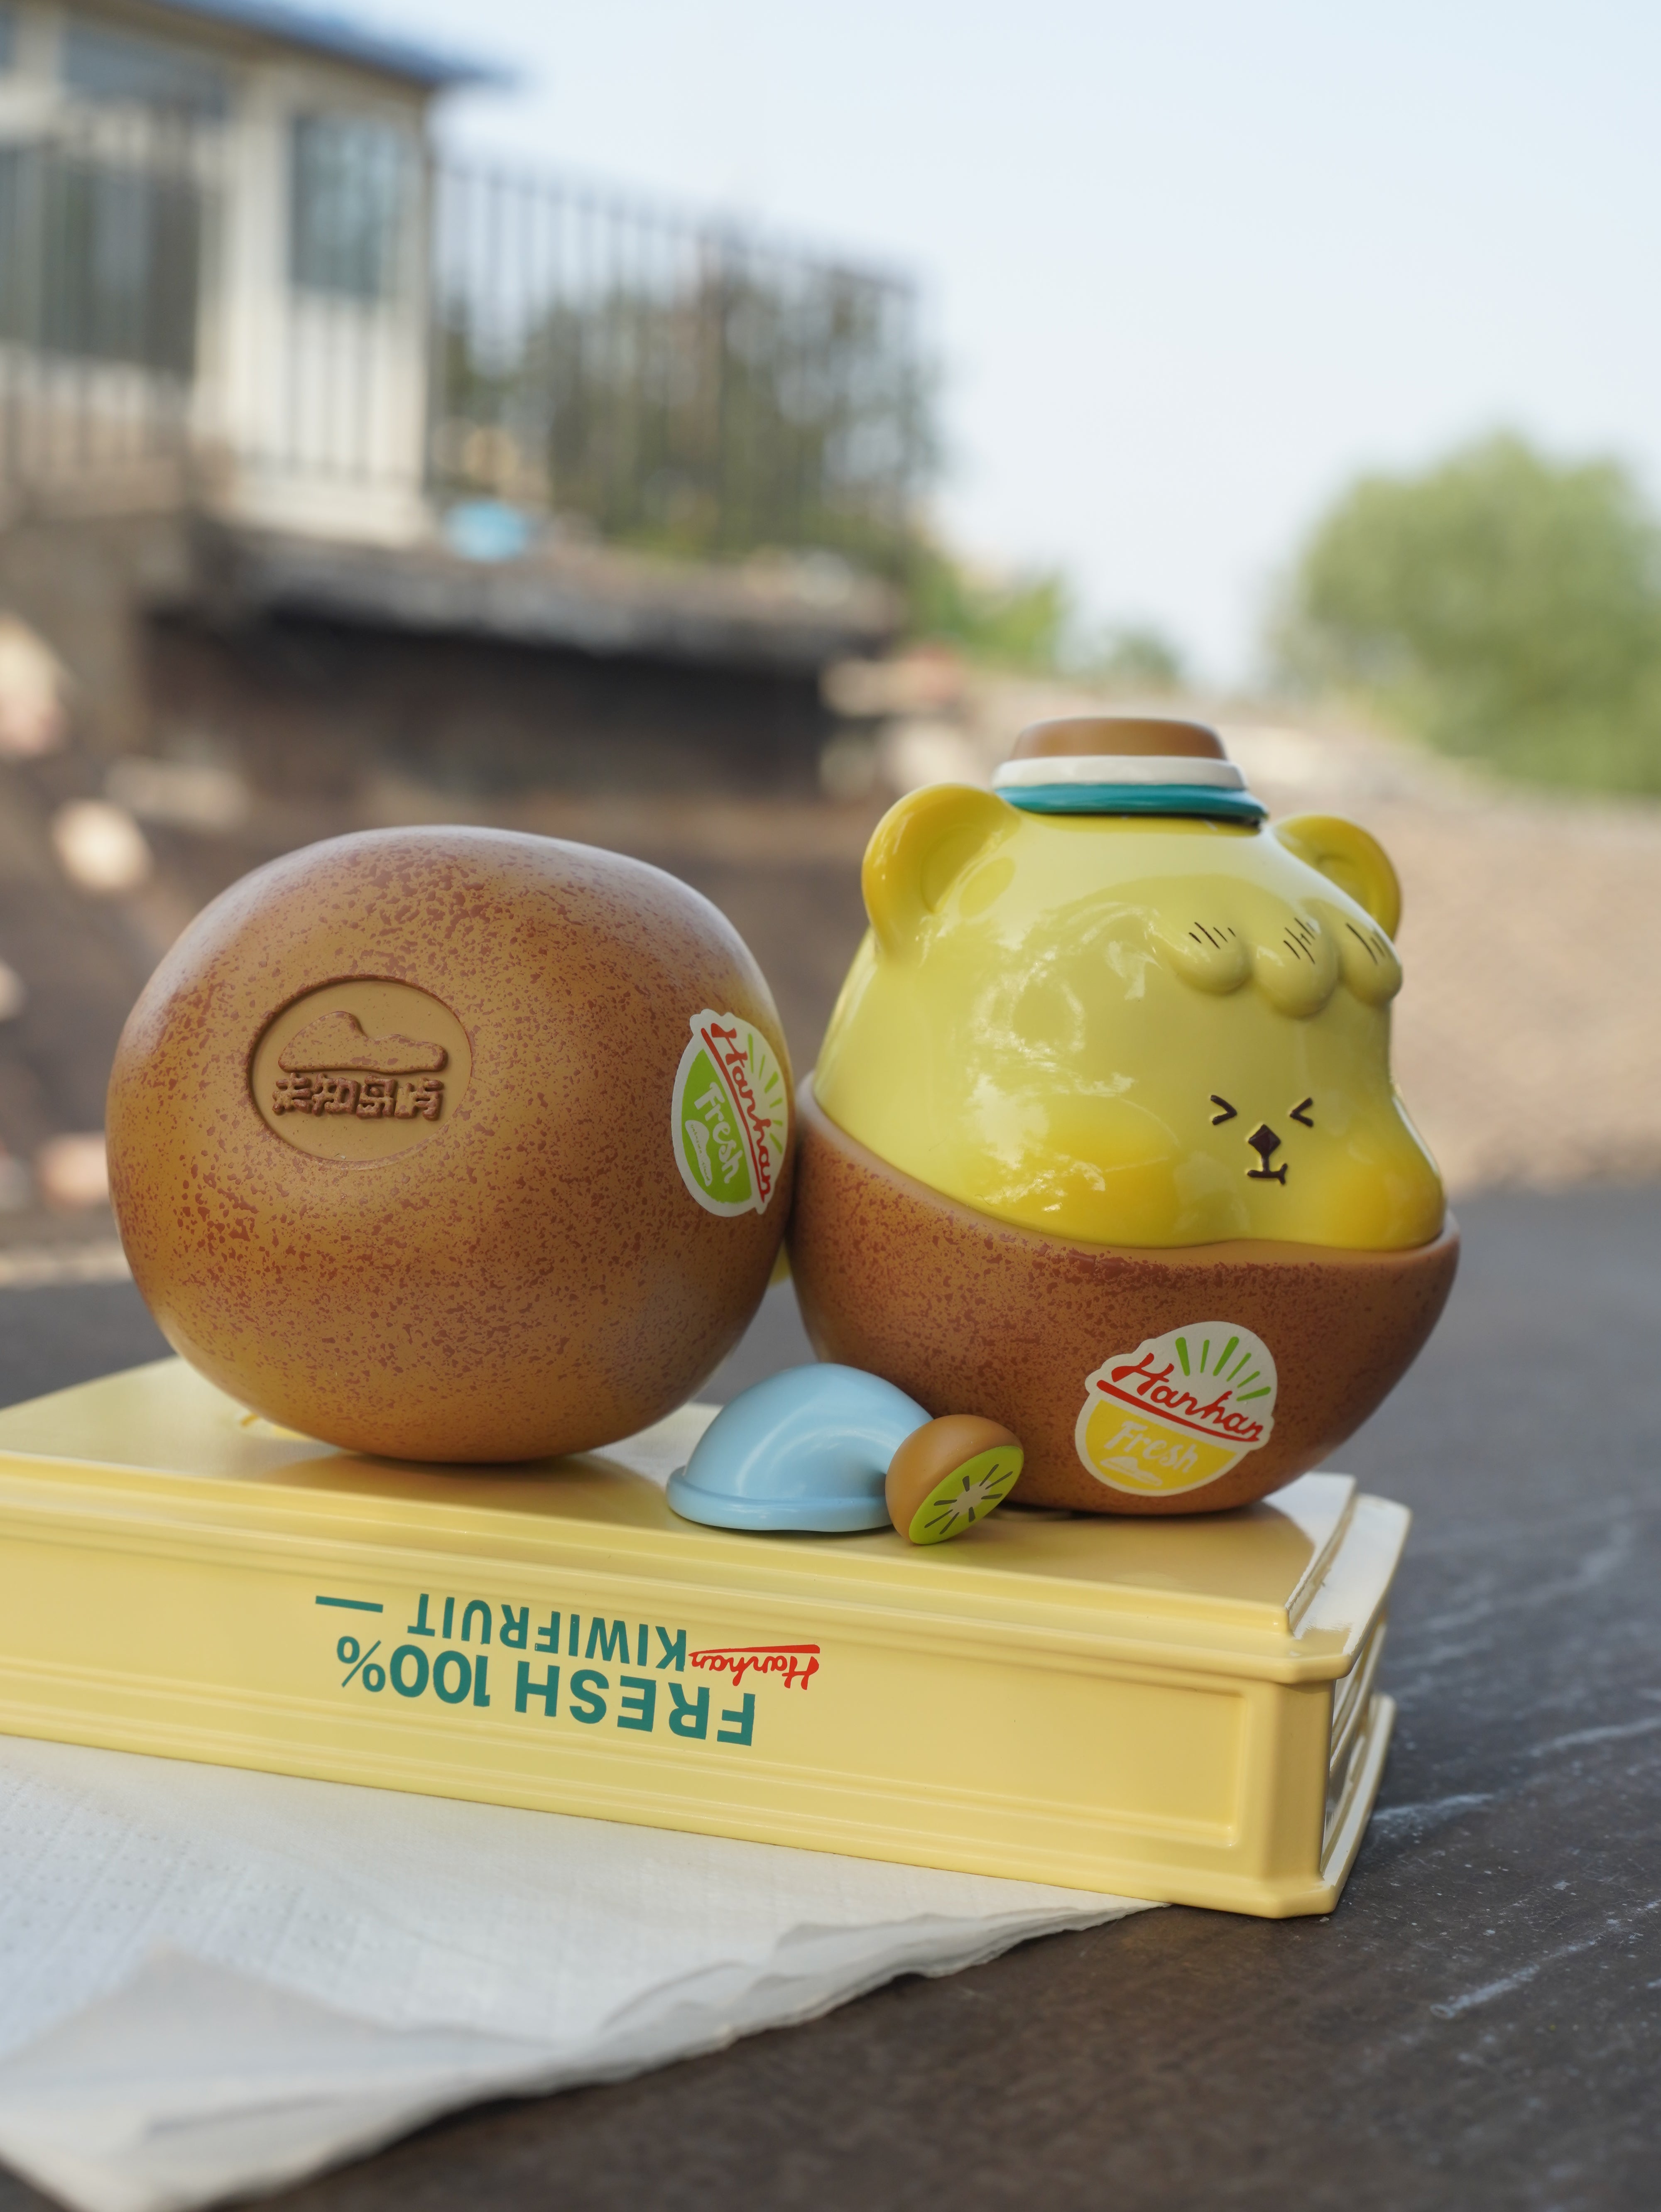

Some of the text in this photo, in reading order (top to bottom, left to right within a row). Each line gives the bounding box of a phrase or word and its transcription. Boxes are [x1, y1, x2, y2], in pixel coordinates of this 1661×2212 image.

[694, 1082, 744, 1184] Fresh
[710, 1023, 772, 1202] Hanhan
[1111, 1352, 1264, 1441] Hanhan
[1103, 1420, 1198, 1473] Fresh
[408, 1594, 686, 1671] KIWIFRUIT
[687, 1644, 820, 1691] Hanhan
[337, 1637, 755, 1745] FRESH 100%
